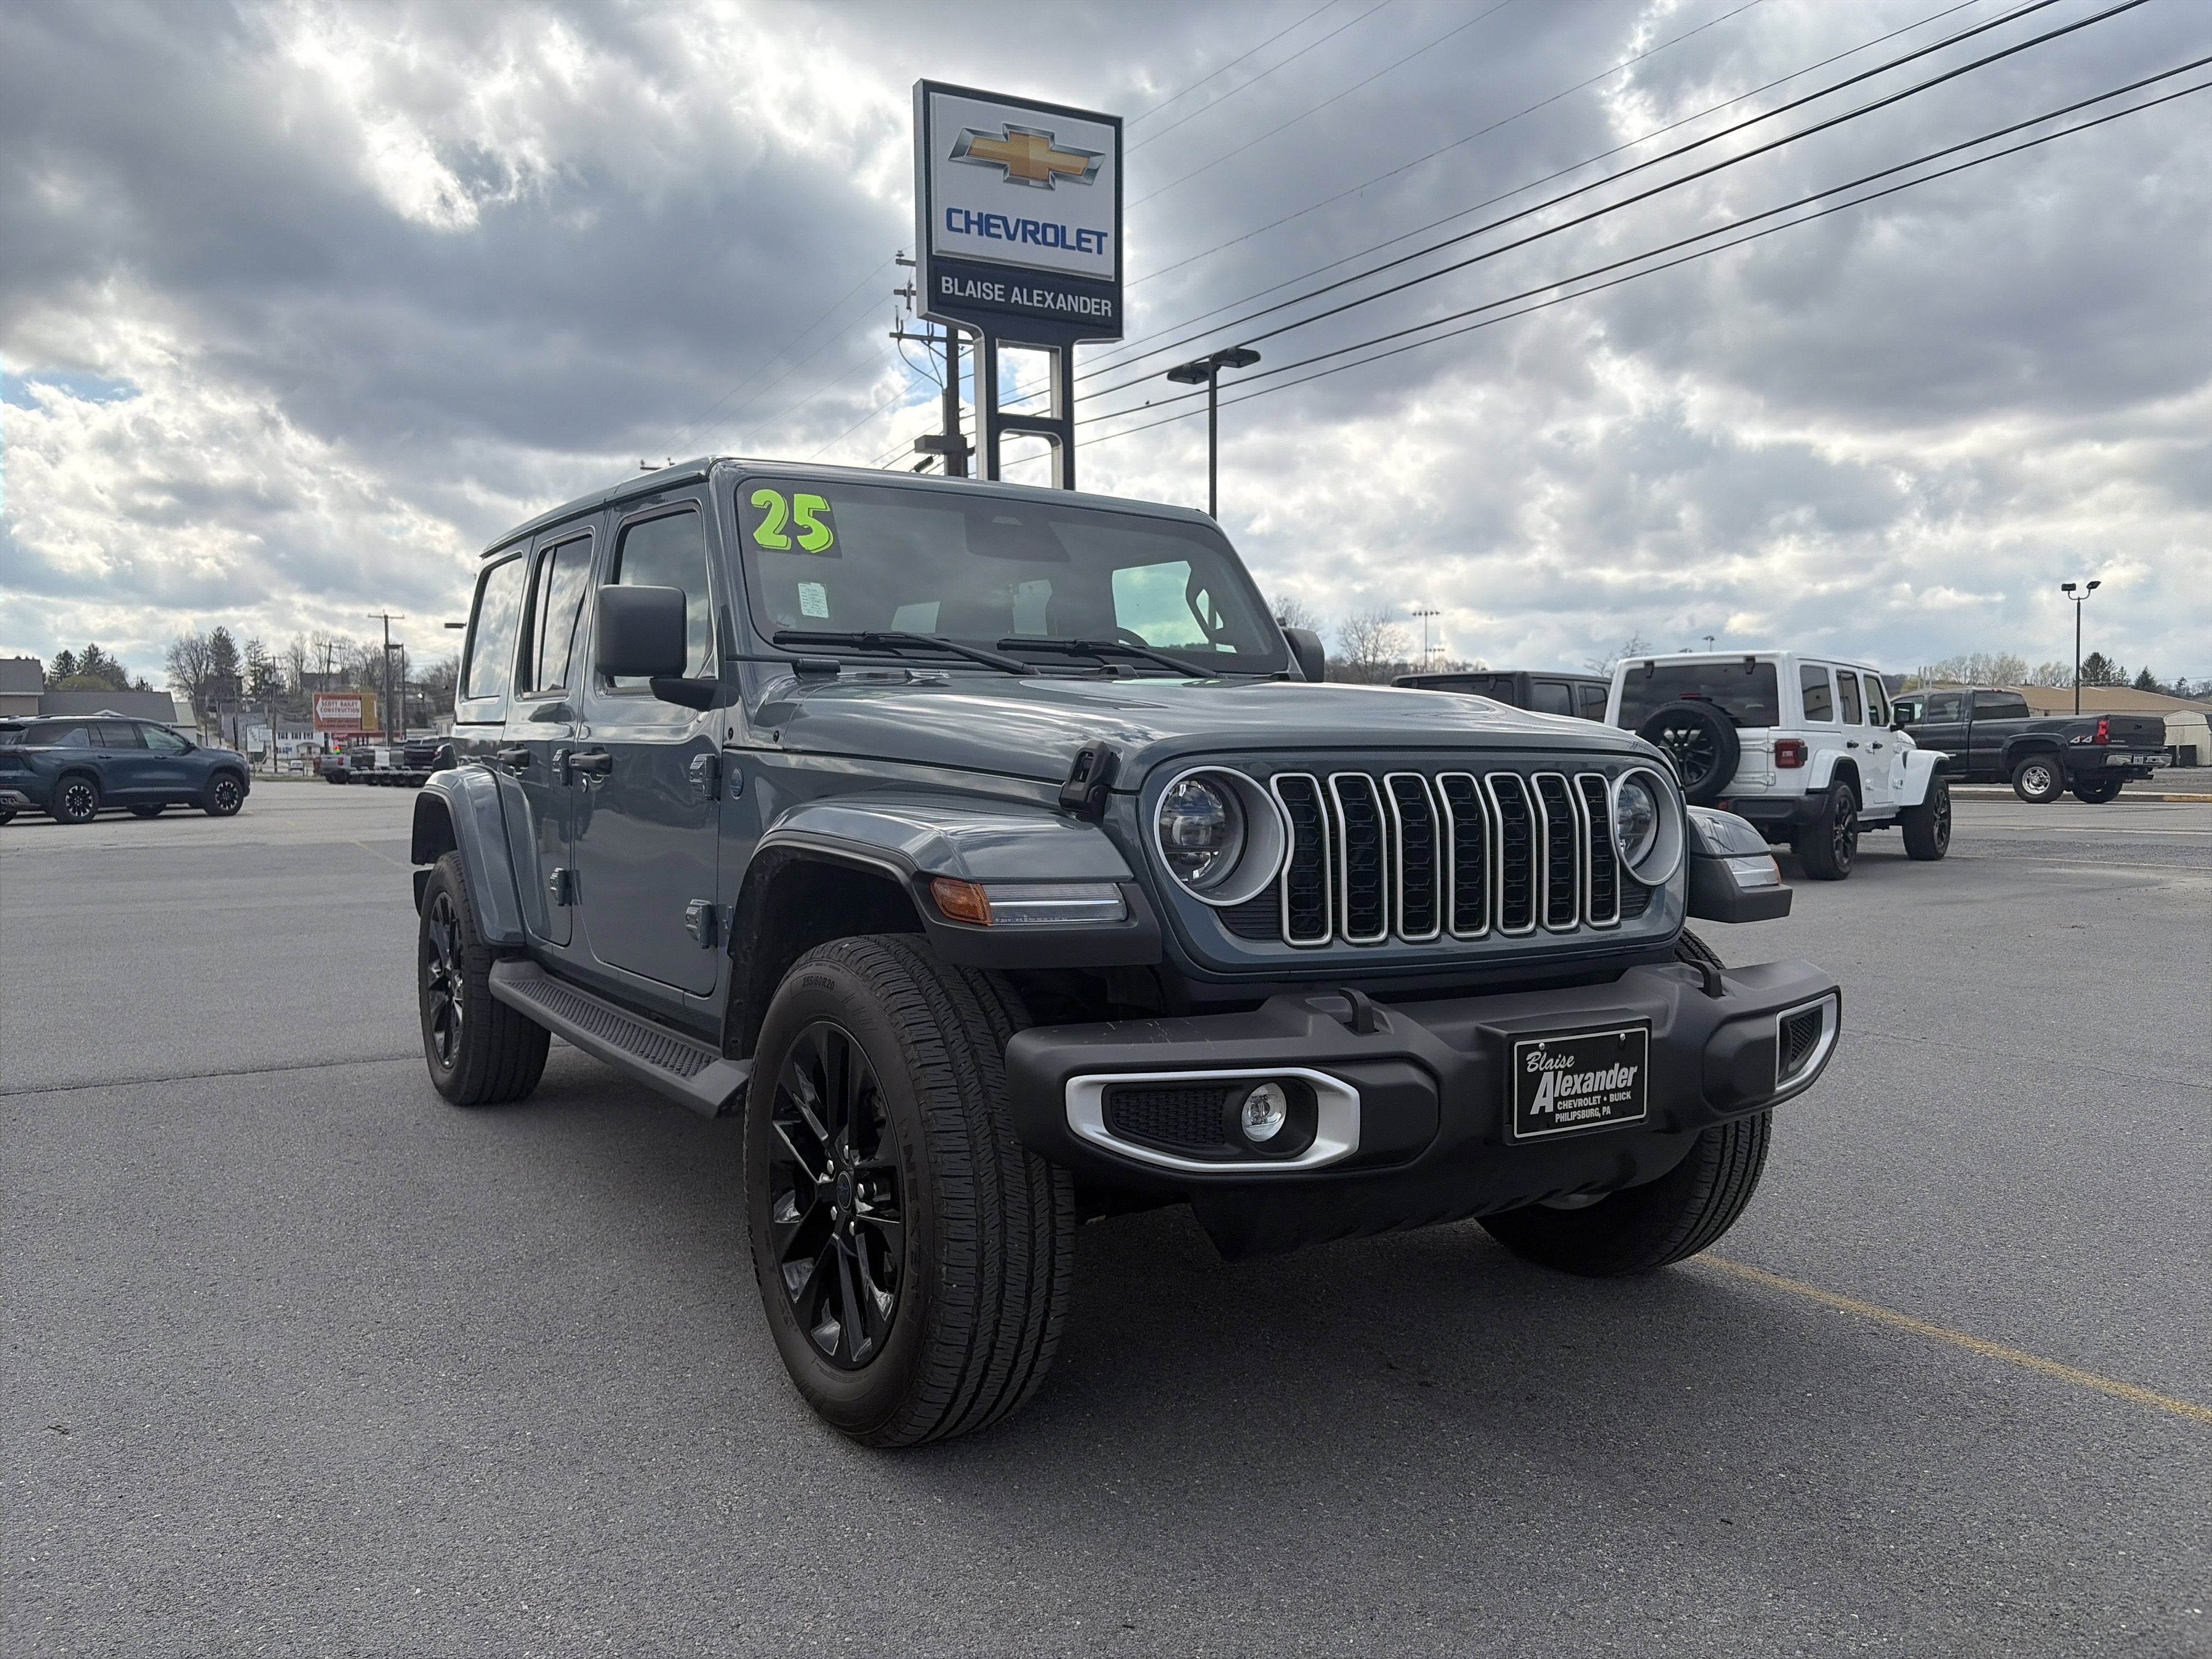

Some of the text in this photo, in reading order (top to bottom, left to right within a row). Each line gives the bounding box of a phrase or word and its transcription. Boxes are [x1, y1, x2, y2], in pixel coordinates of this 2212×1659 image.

[946, 207, 1108, 255] CHEVROLET
[941, 276, 1112, 317] BLAISE ALEXANDER
[751, 489, 834, 554] 25
[803, 975, 835, 990] 255/60R20
[1526, 1051, 1575, 1073] Blaise
[1530, 1063, 1638, 1115] Alexander
[1557, 1091, 1632, 1110] CHEVROLET BUICK
[1555, 1105, 1611, 1123] PHILIPSBURG, PA
